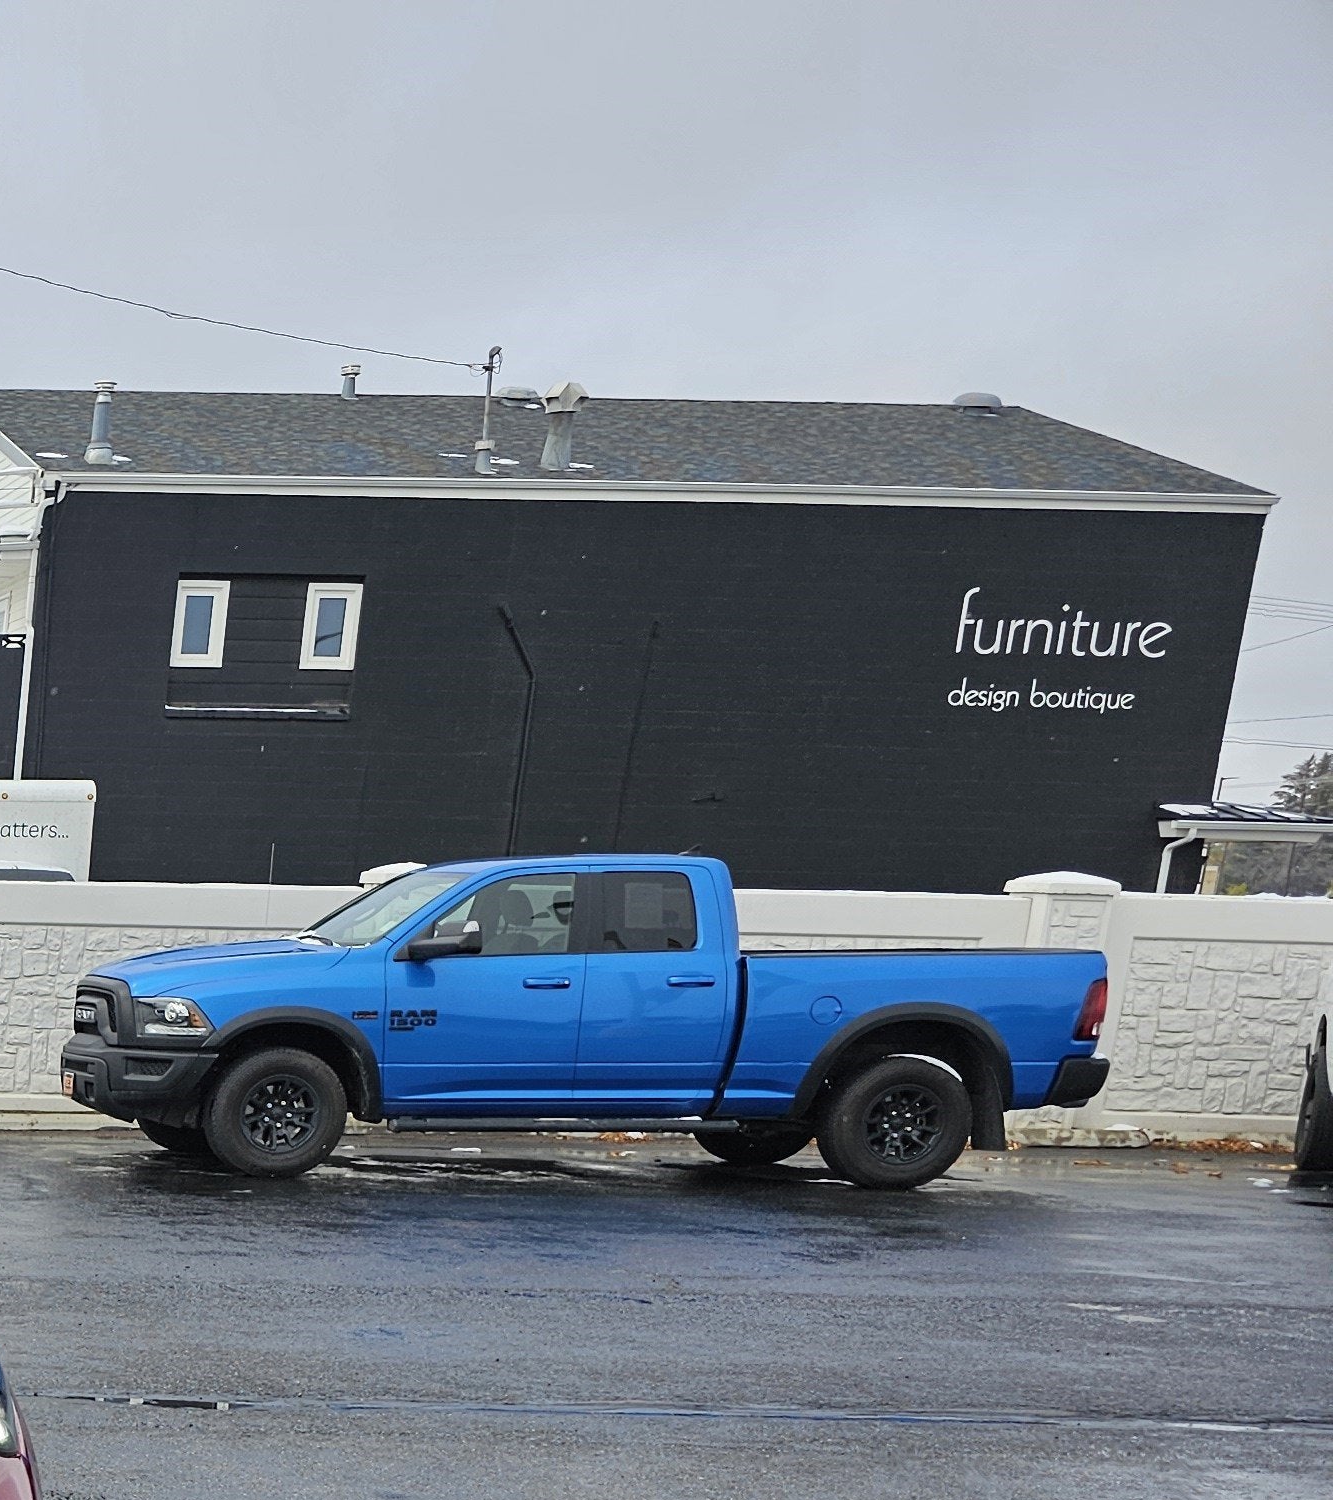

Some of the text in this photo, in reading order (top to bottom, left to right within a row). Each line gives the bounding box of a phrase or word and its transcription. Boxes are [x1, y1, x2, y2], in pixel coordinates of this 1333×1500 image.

[955, 586, 1173, 659] furniture
[947, 676, 1136, 715] design boutique
[390, 1009, 438, 1018] RAM
[390, 1018, 437, 1027] 1500
